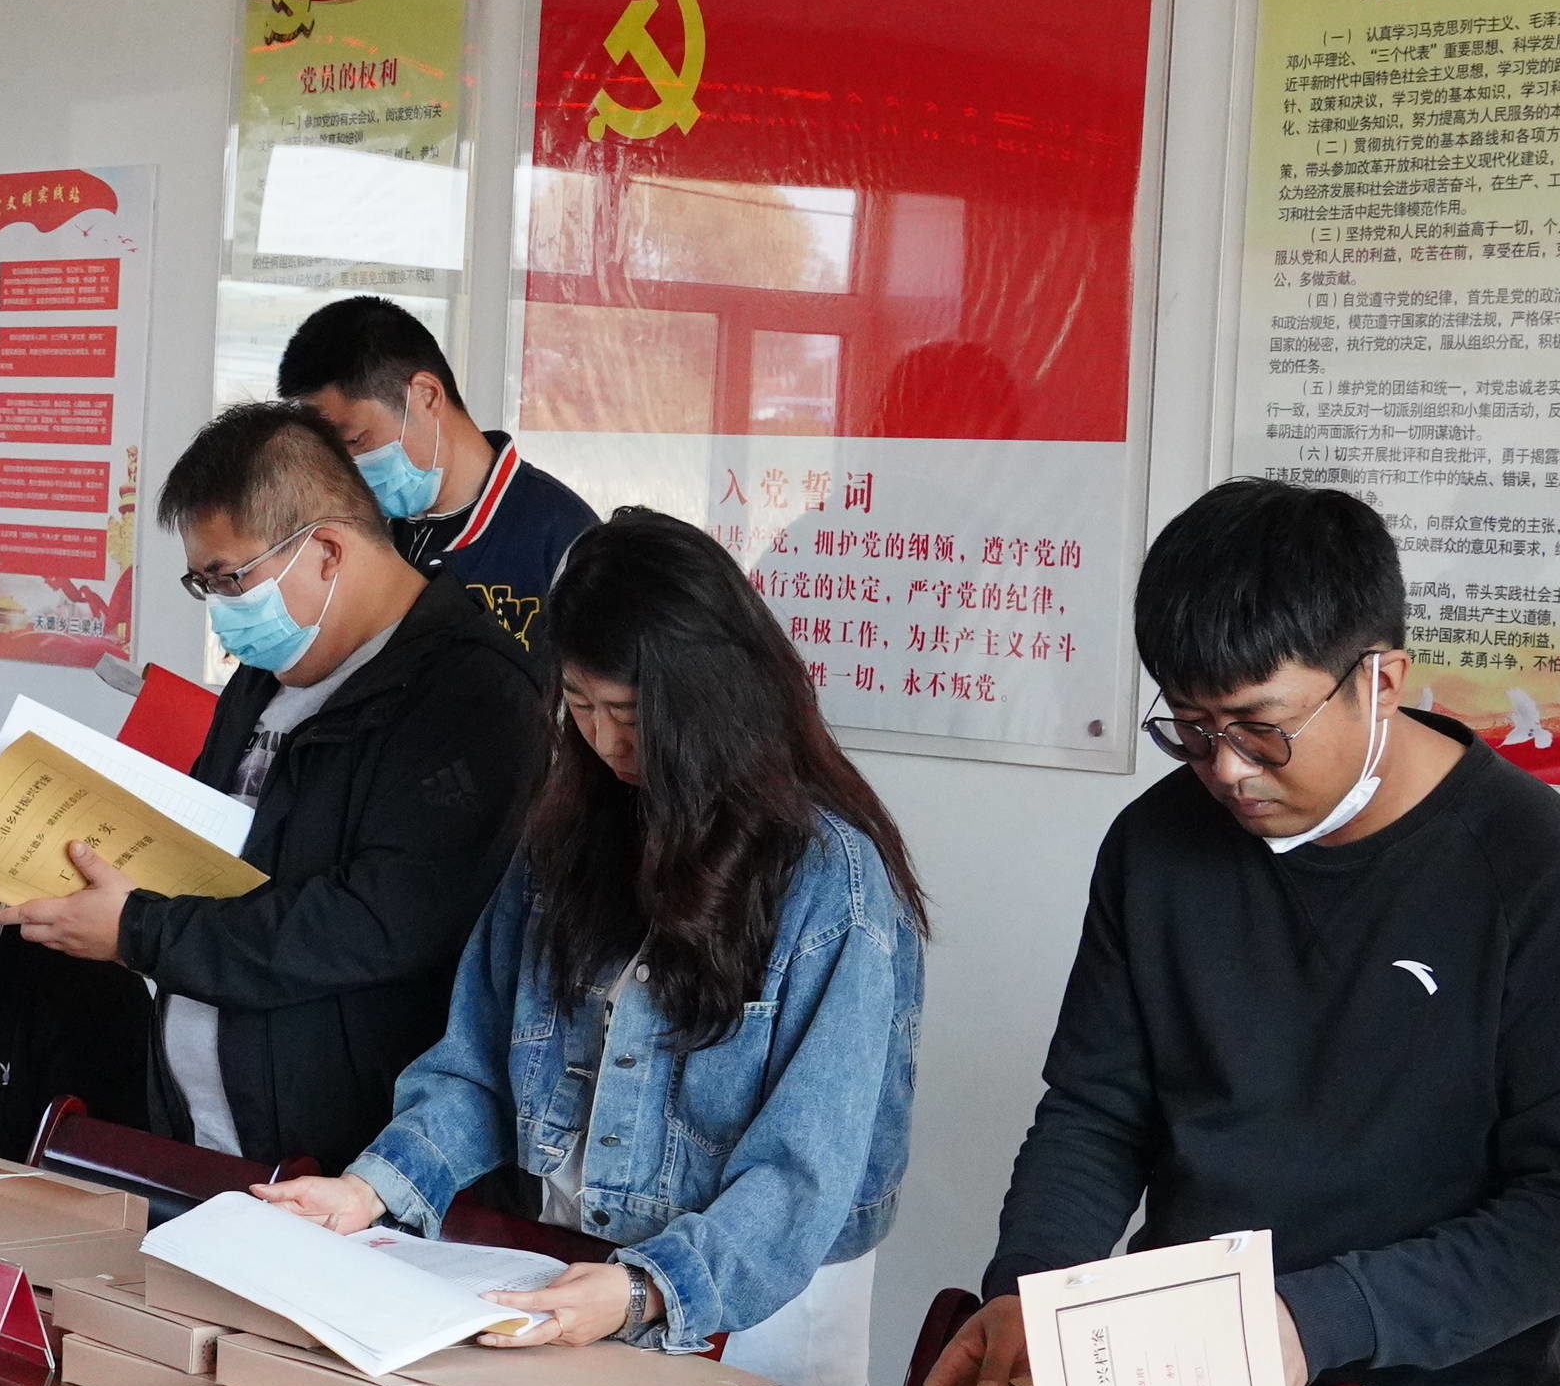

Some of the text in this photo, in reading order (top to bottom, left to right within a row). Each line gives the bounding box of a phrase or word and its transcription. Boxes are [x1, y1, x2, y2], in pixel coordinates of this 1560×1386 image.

[300, 57, 399, 94] 党员的权利
[1277, 198, 1467, 223] 习和社会生活中起先锋模范作用。
[1273, 270, 1359, 287] 公，多做贡献。
[1269, 358, 1326, 376] 党的任务。
[1266, 423, 1484, 442] 奉阴违的两面派行为和一切阴谋诡计。
[720, 468, 874, 514] 入党誓词
[789, 615, 1077, 663] 积极工作，为共产主义奋斗
